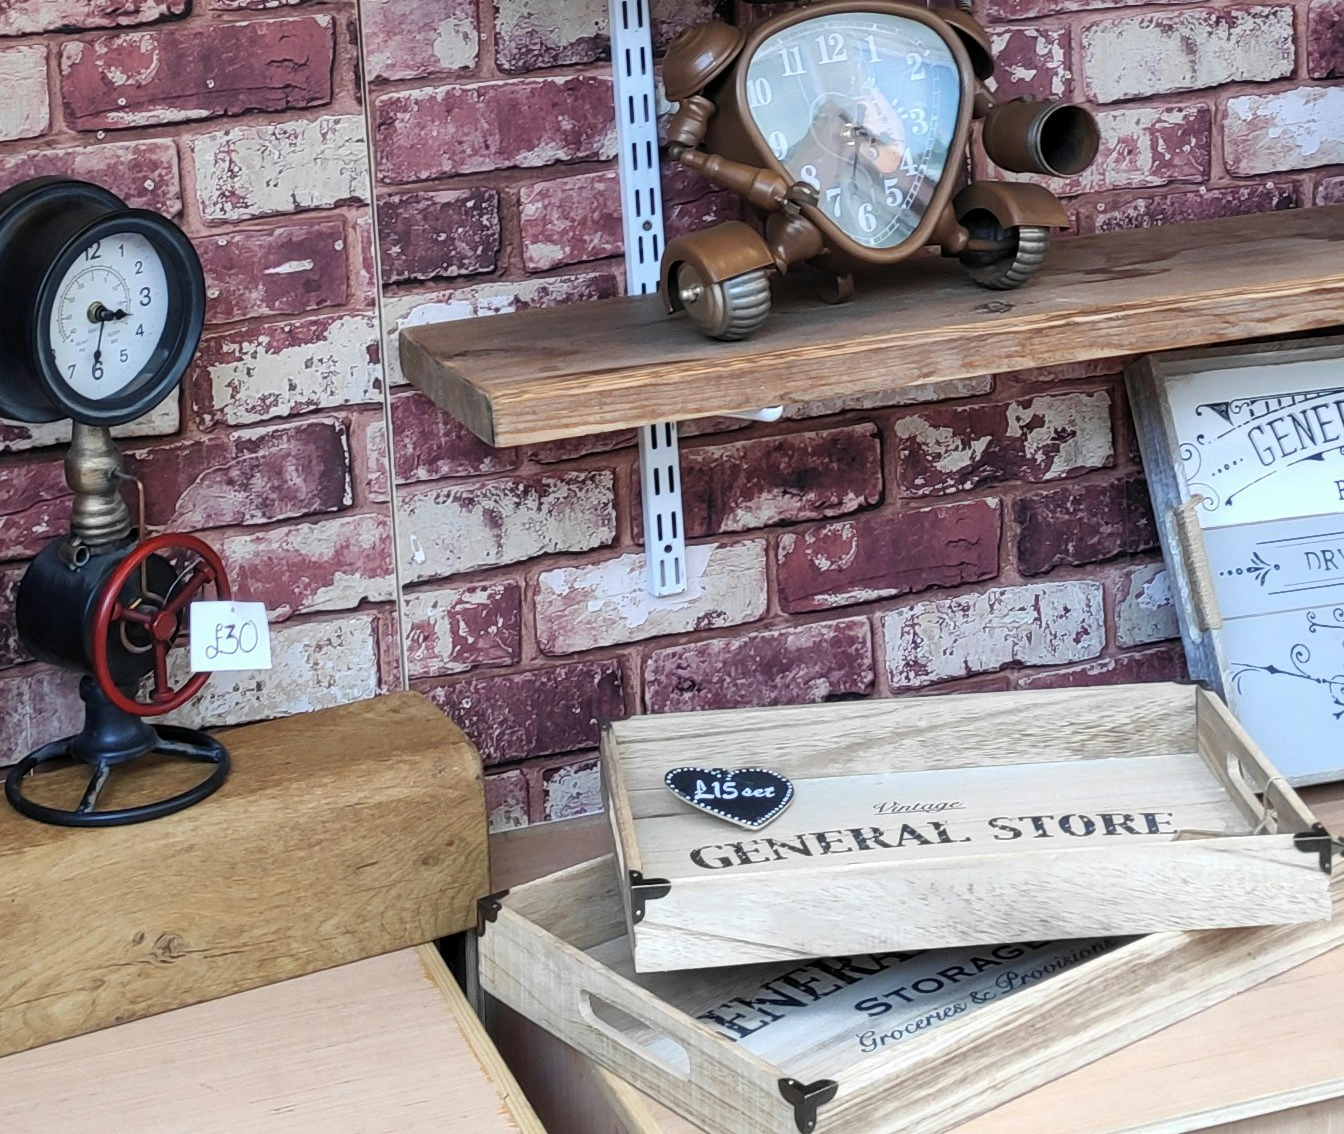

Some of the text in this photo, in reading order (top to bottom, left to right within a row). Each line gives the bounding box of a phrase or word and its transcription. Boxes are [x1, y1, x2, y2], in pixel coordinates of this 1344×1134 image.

[779, 46, 807, 77] 11
[815, 33, 848, 65] 12
[864, 34, 882, 63] 1
[907, 52, 926, 81] 2
[746, 77, 772, 108] 10
[909, 108, 929, 136] 3
[768, 130, 789, 161] 9
[900, 147, 918, 177] 4
[800, 164, 821, 191] 8
[883, 177, 903, 207] 5
[825, 187, 842, 217] 7
[857, 203, 877, 232] 6
[84, 241, 102, 262] 12
[118, 243, 125, 258] 1
[134, 260, 144, 275] 2
[139, 286, 152, 307] 3
[135, 323, 145, 337] 4
[120, 348, 129, 363] 5
[67, 363, 77, 380] 7
[91, 360, 104, 381] 6
[205, 619, 259, 660] £30
[694, 779, 777, 801] £15 set
[872, 799, 966, 815] Vintage
[689, 811, 1178, 870] GENERAL STORE
[857, 1001, 967, 1054] Groceries
[970, 991, 997, 1005] &
